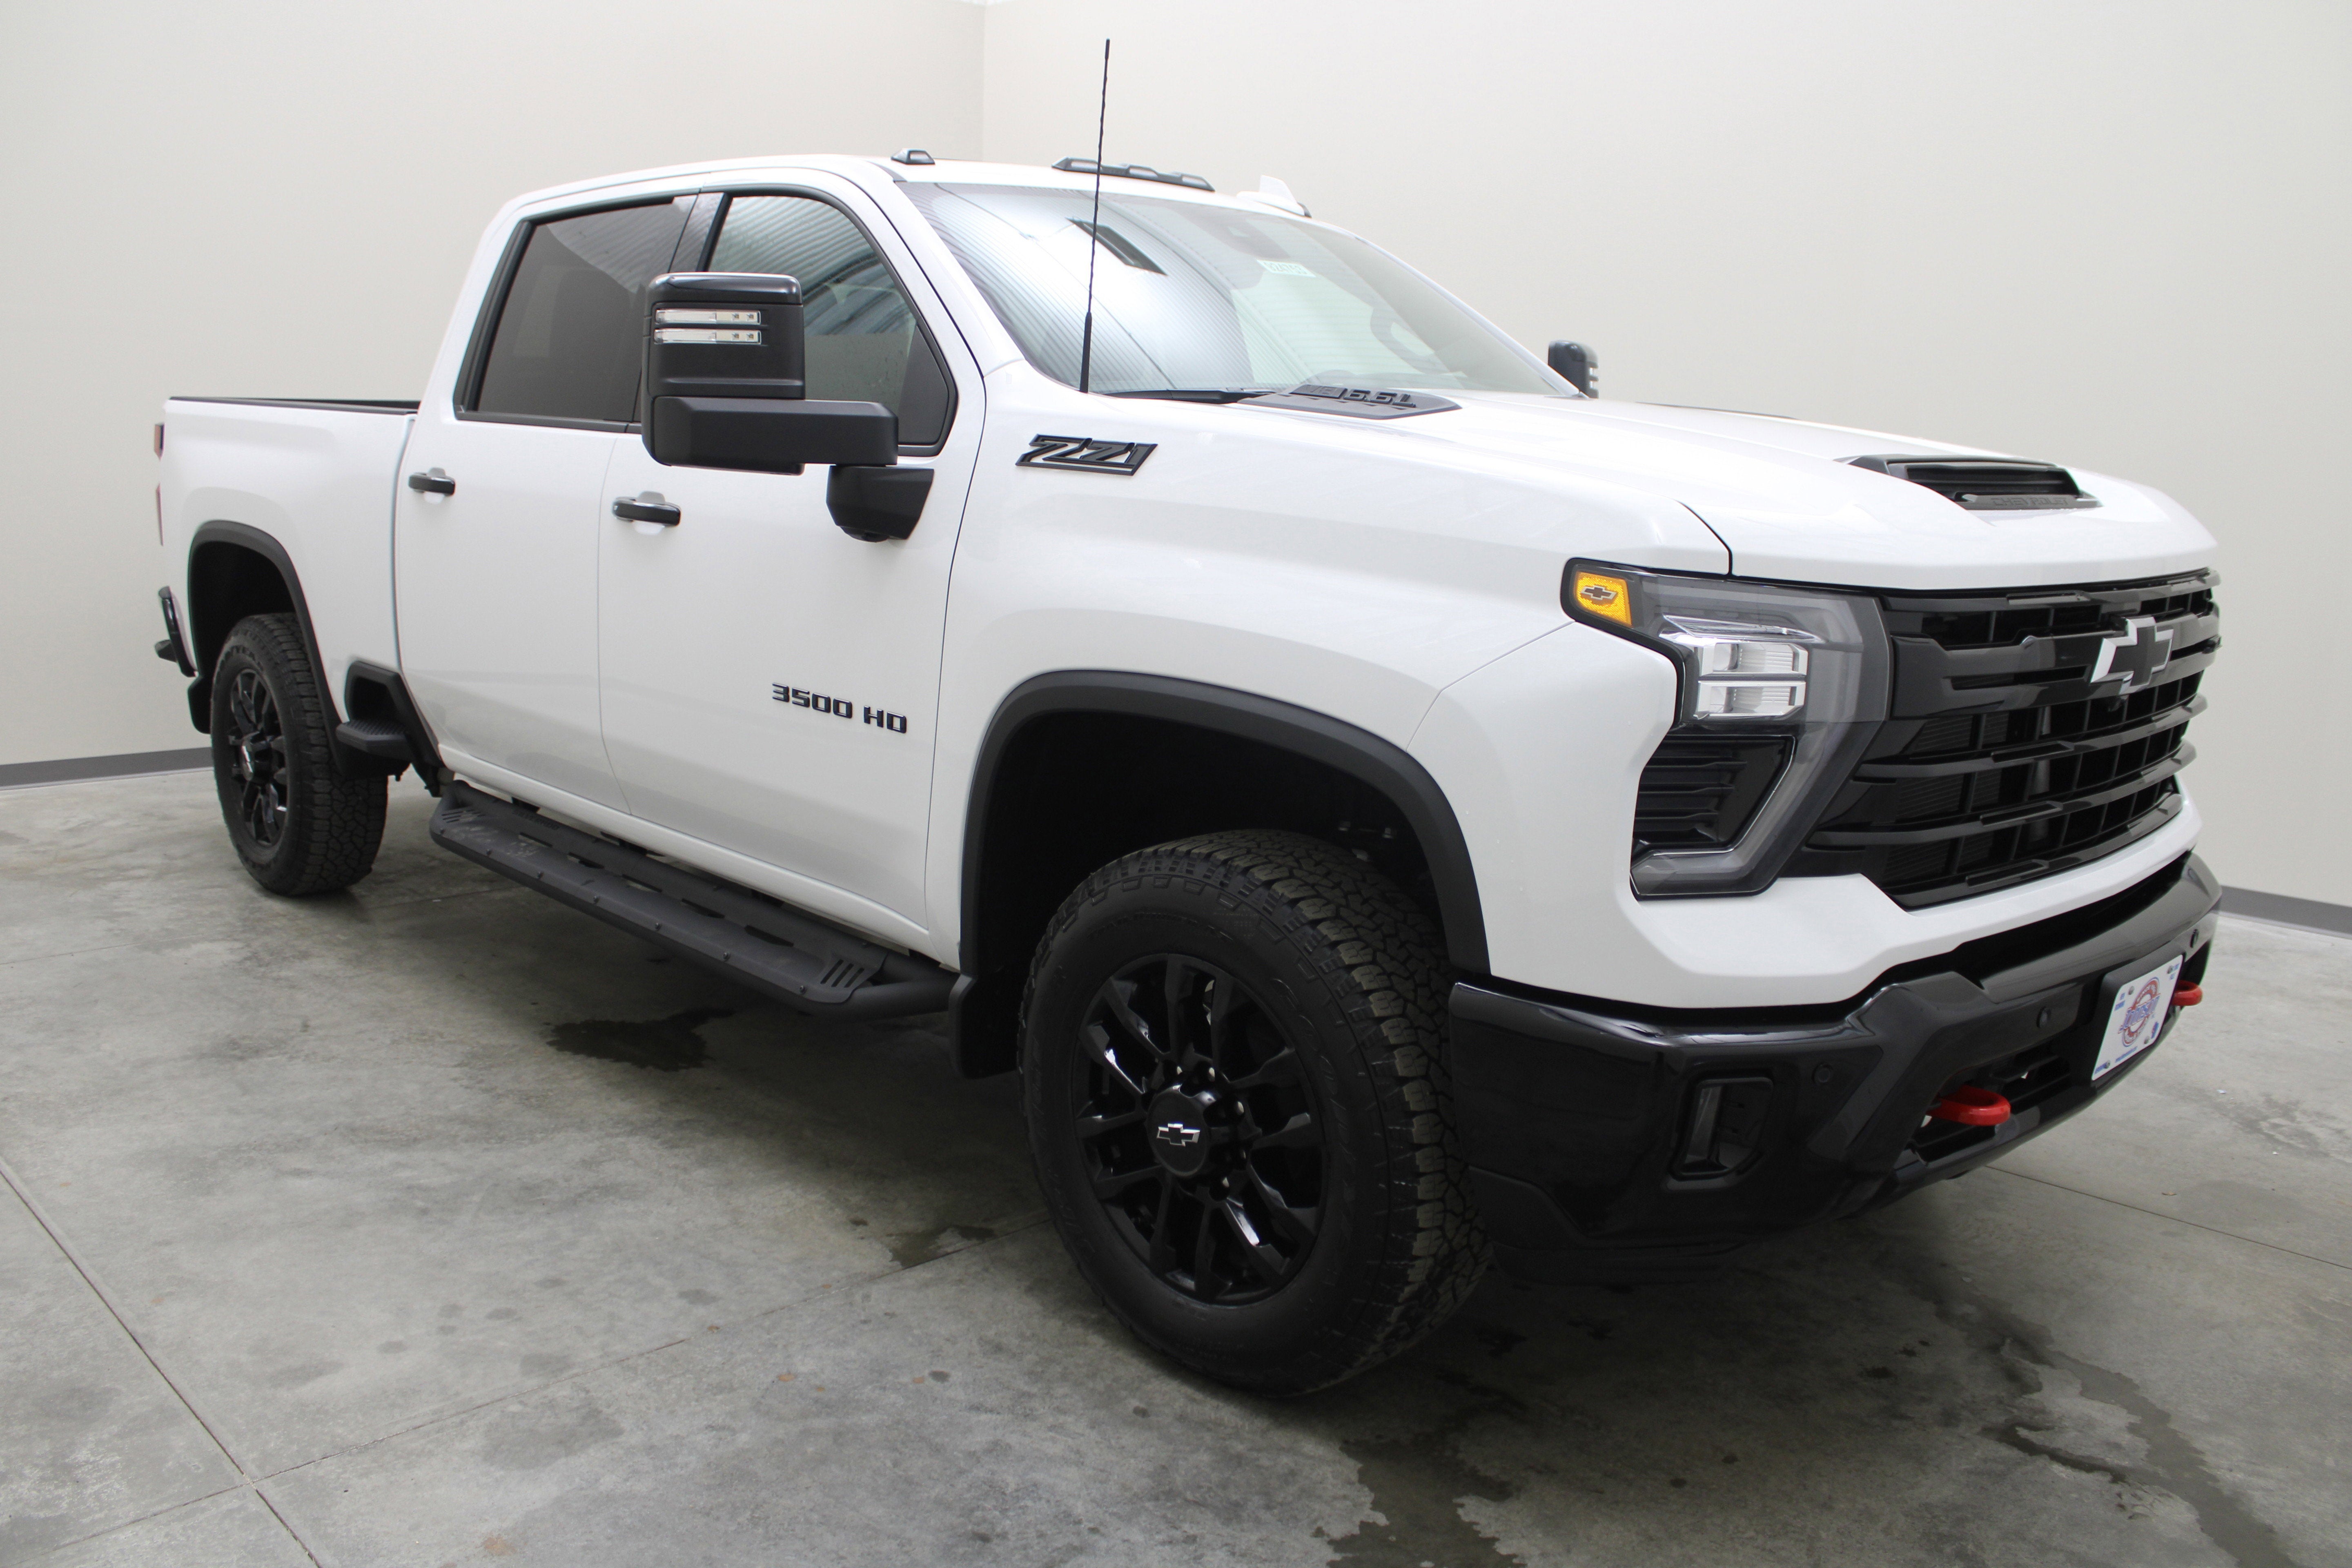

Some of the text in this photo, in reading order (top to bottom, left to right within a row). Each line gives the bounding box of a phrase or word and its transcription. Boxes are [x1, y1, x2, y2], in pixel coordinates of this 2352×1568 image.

[1343, 388, 1416, 408] 6.6L
[1015, 434, 1158, 476] Z71
[1991, 497, 2068, 506] CHEVROLET
[772, 682, 907, 734] 3500 HD
